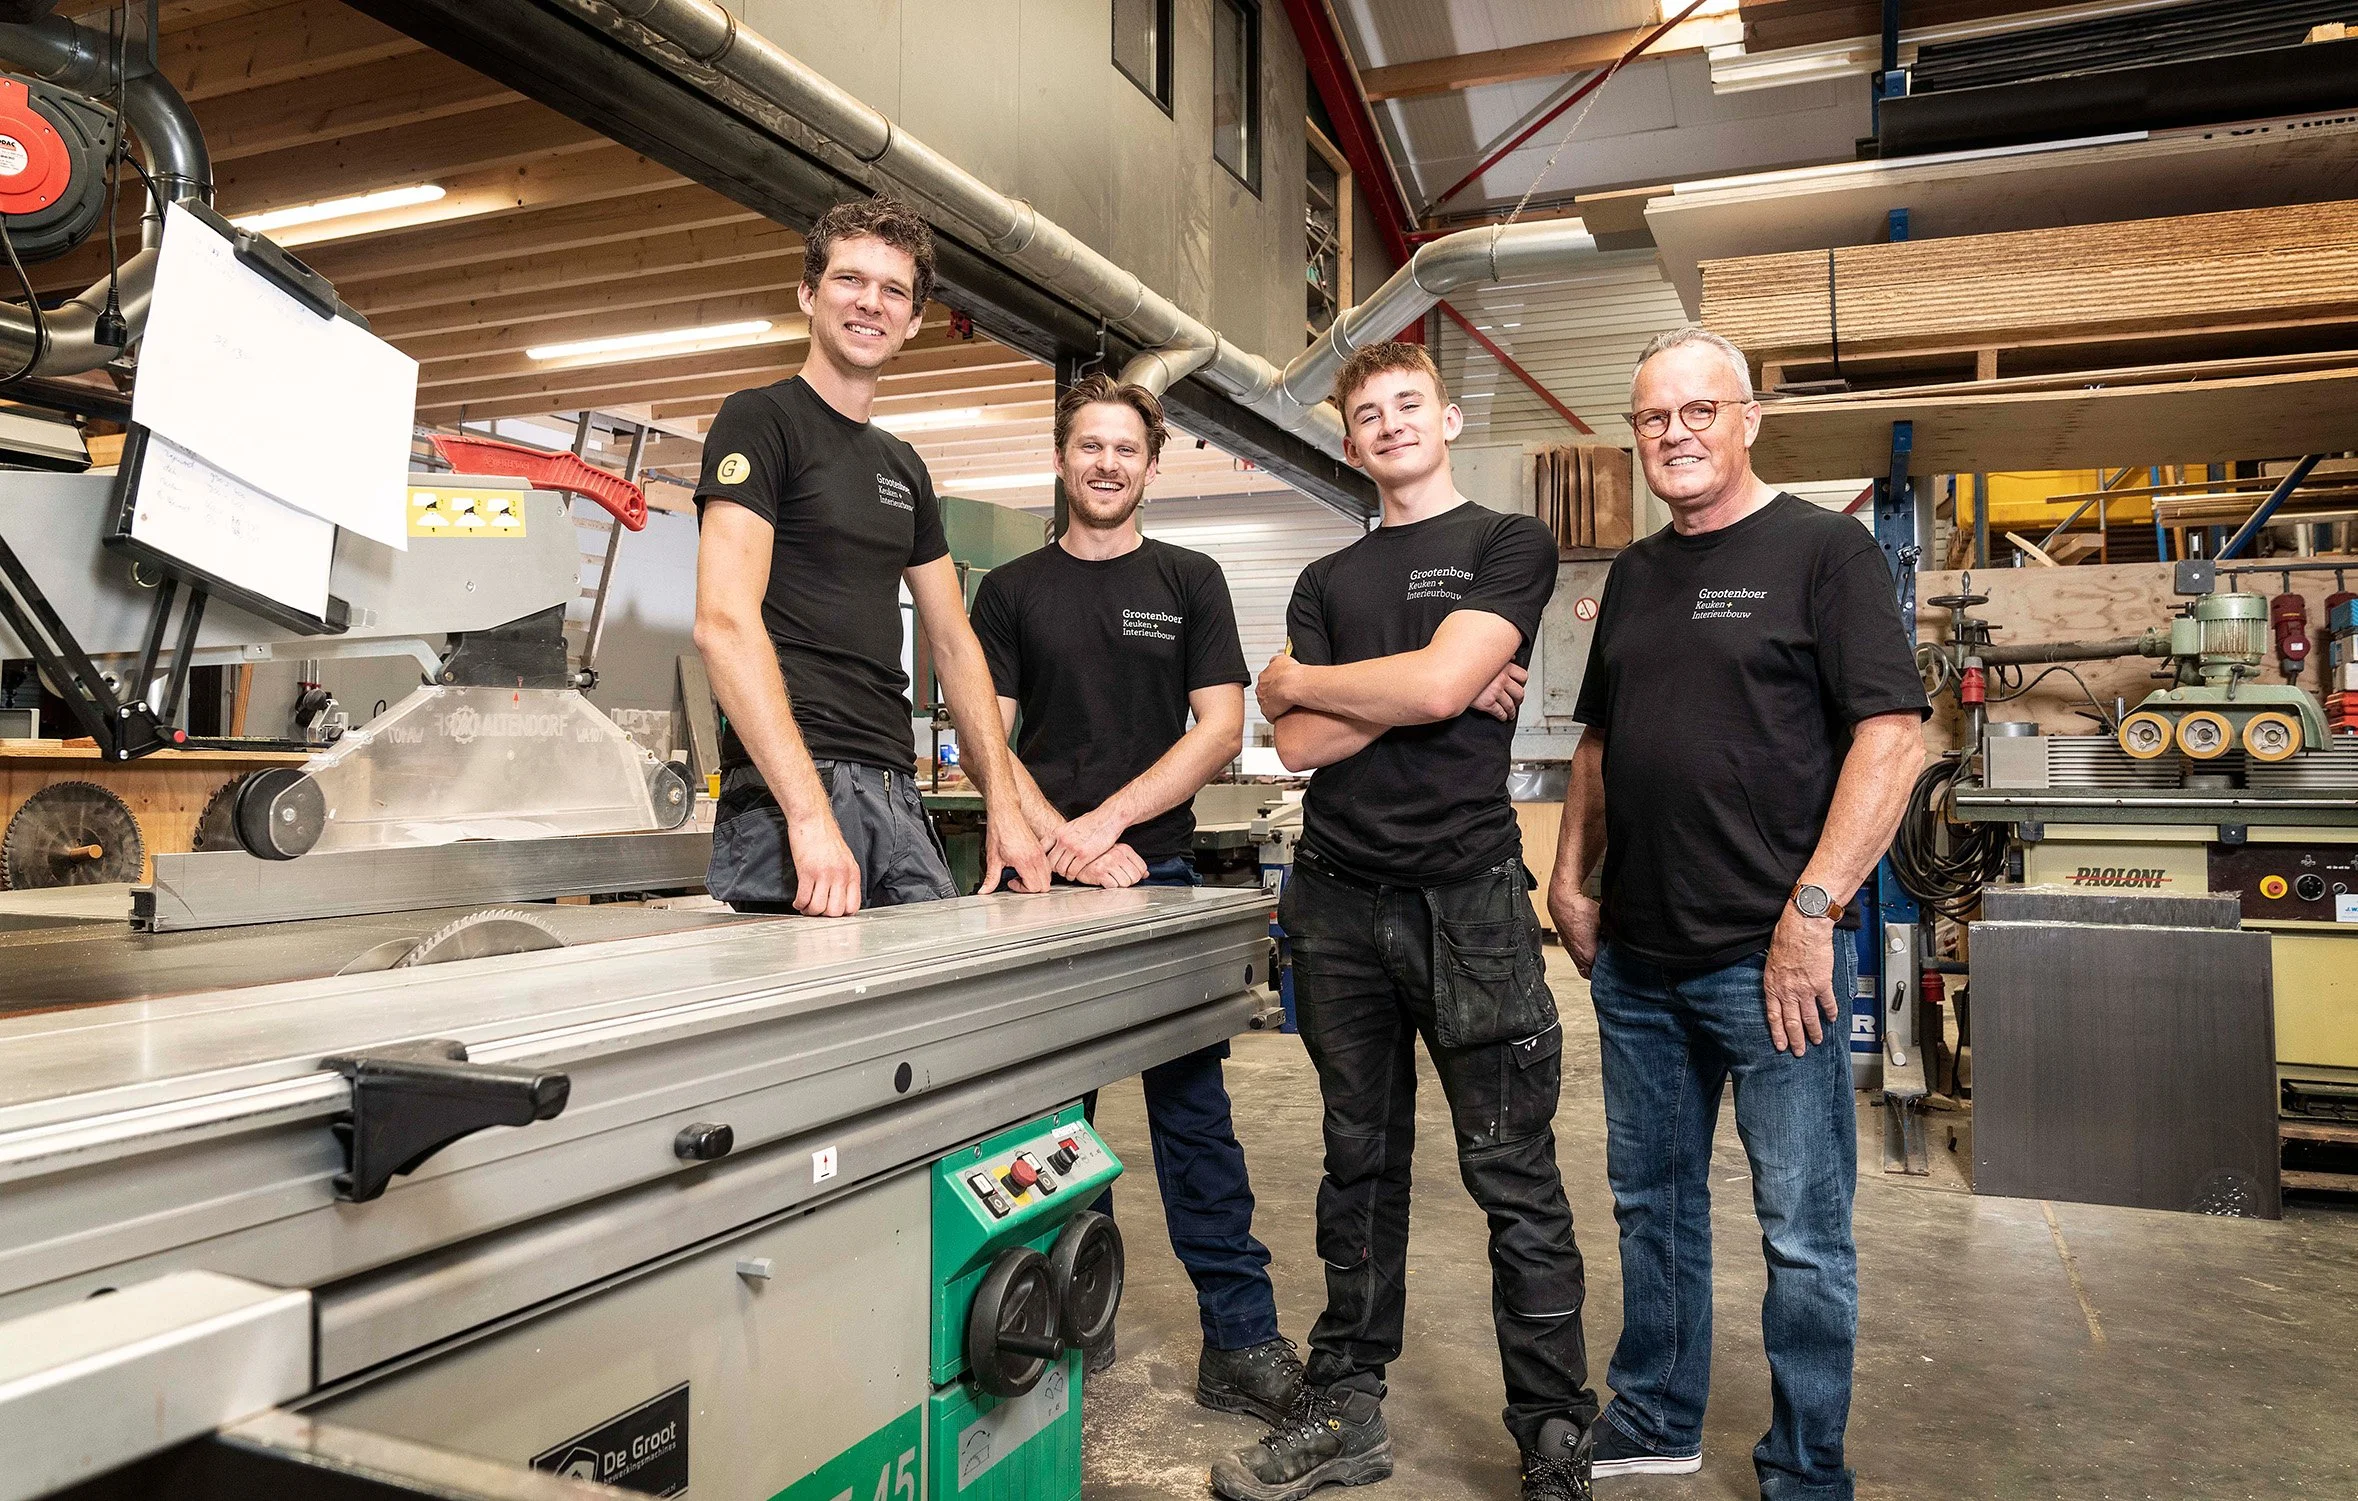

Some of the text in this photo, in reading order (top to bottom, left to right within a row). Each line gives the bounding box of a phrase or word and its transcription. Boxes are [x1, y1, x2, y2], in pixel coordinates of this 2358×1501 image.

[1408, 580, 1436, 591] Keuken
[1699, 588, 1768, 599] Grootenboer
[1695, 600, 1726, 609] Keuken
[1122, 609, 1183, 624] Grootenboer
[1691, 610, 1752, 620] Interieurbouw
[1122, 619, 1152, 629] Keuken
[1122, 628, 1176, 640] Interieurbouw
[2073, 867, 2166, 888] PAOLONI
[603, 1420, 677, 1476] De Groot
